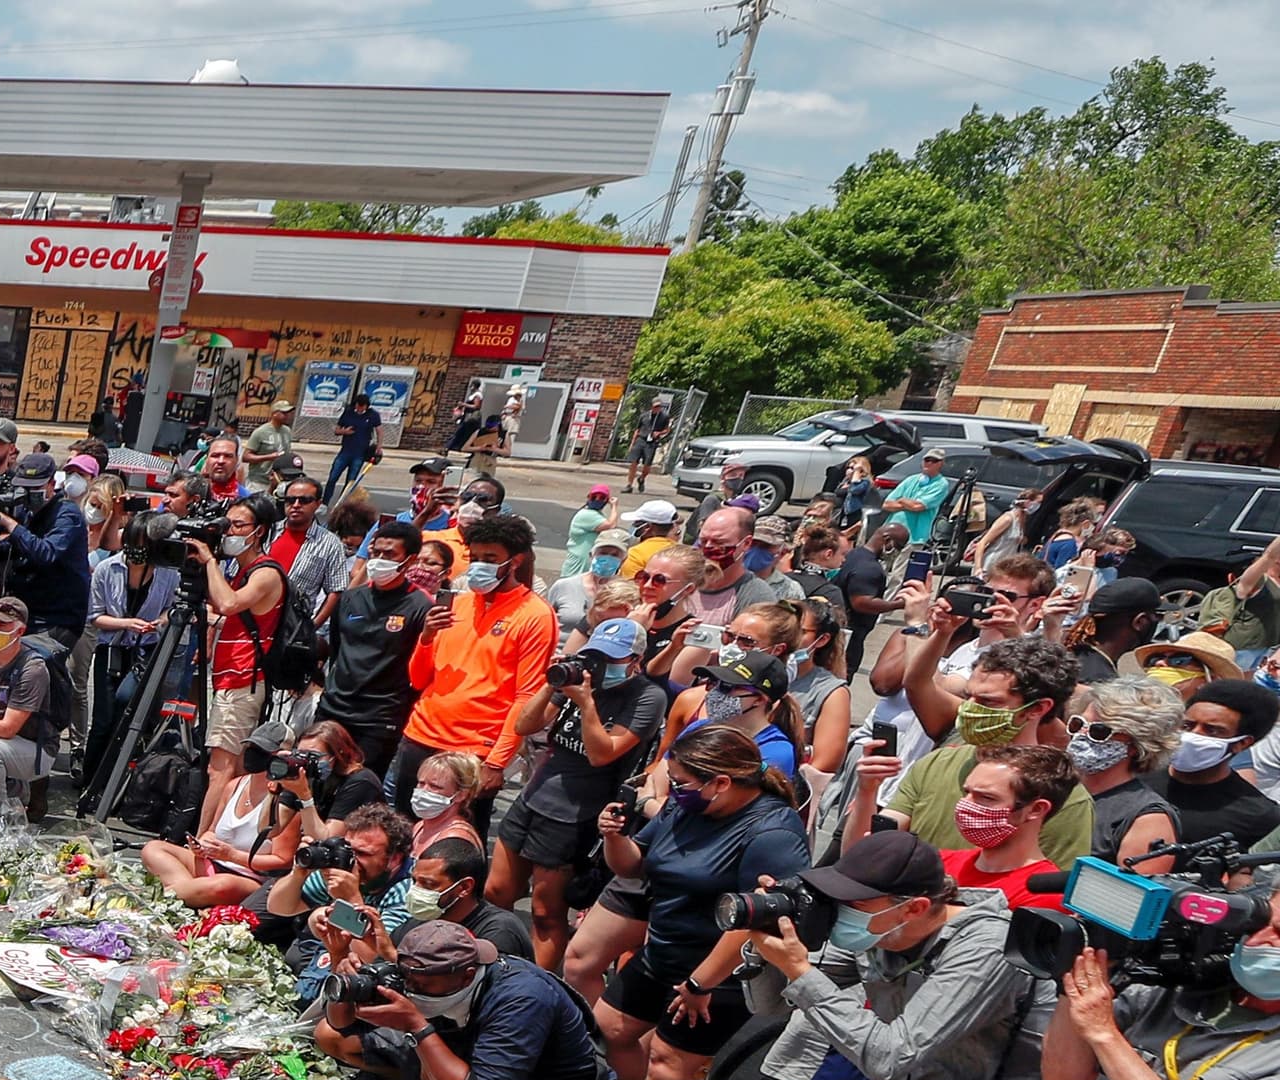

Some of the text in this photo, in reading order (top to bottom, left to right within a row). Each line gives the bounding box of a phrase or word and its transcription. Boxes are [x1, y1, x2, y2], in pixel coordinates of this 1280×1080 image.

[25, 236, 208, 276] Speedw
[153, 276, 161, 287] 2
[79, 311, 101, 327] 12
[465, 323, 516, 336] WELLS
[331, 330, 352, 345] will
[462, 334, 513, 347] FARGO
[520, 331, 548, 344] ATM
[575, 380, 602, 393] AIR
